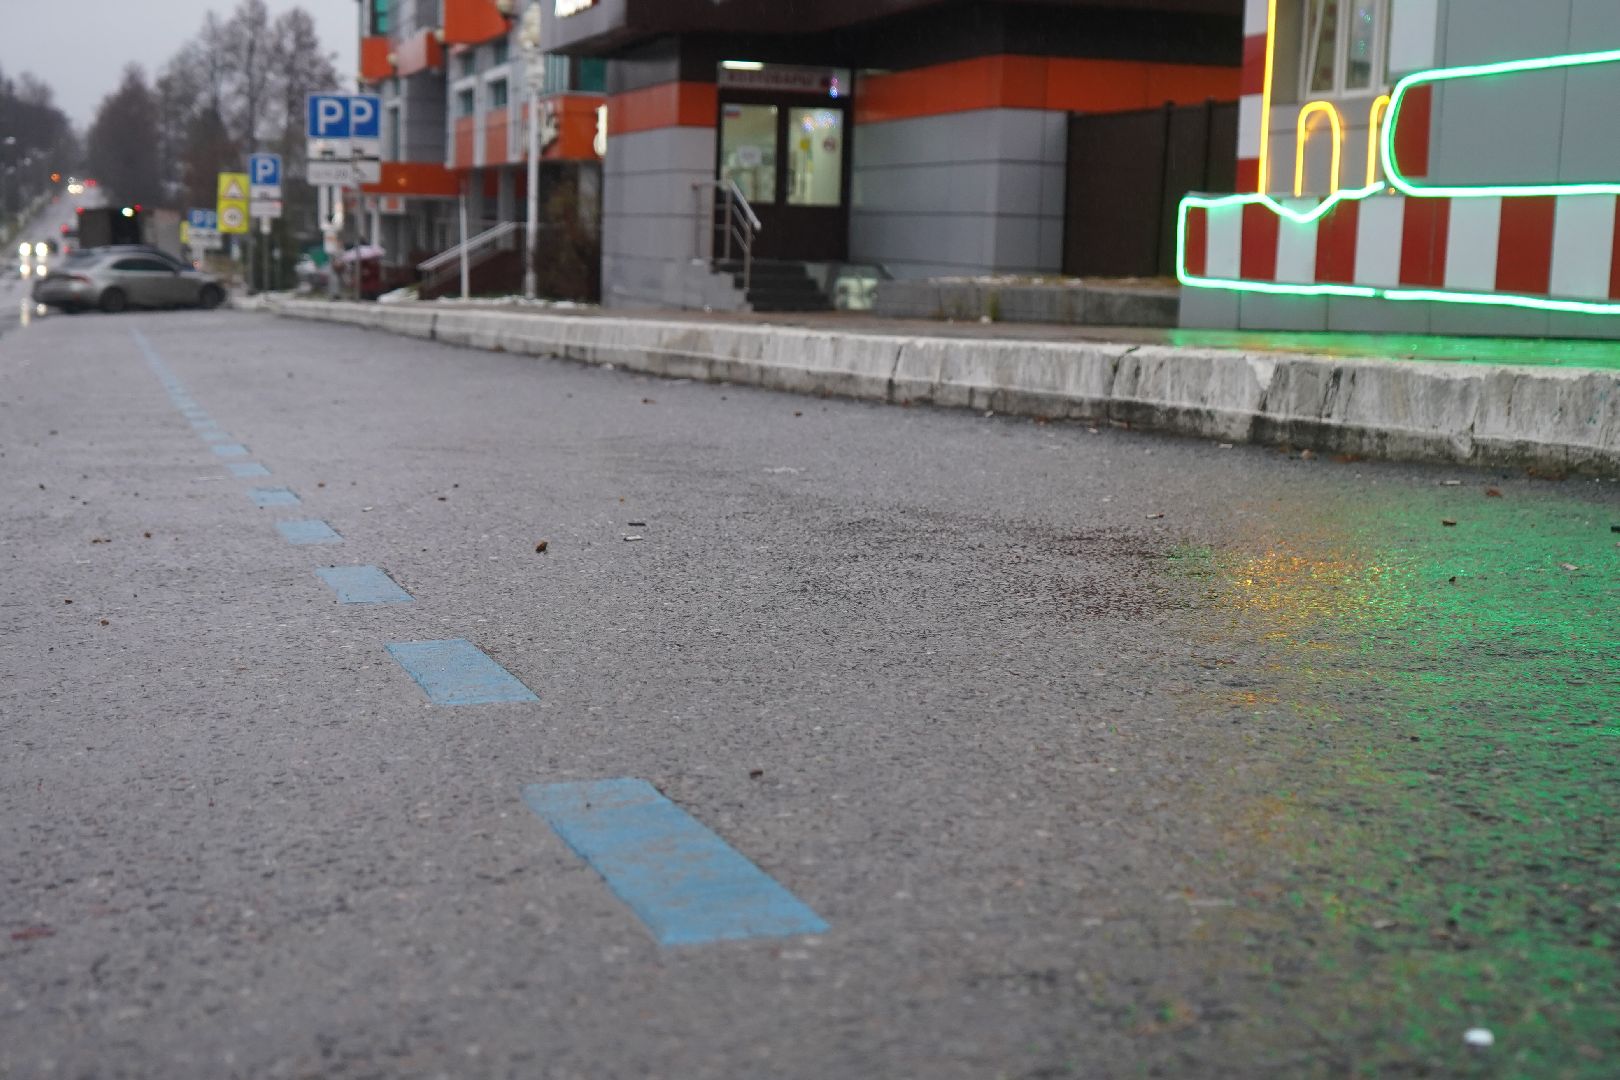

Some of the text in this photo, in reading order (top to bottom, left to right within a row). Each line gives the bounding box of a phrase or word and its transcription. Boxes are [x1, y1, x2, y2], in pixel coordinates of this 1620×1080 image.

[317, 98, 374, 136] P P
[256, 159, 275, 184] P
